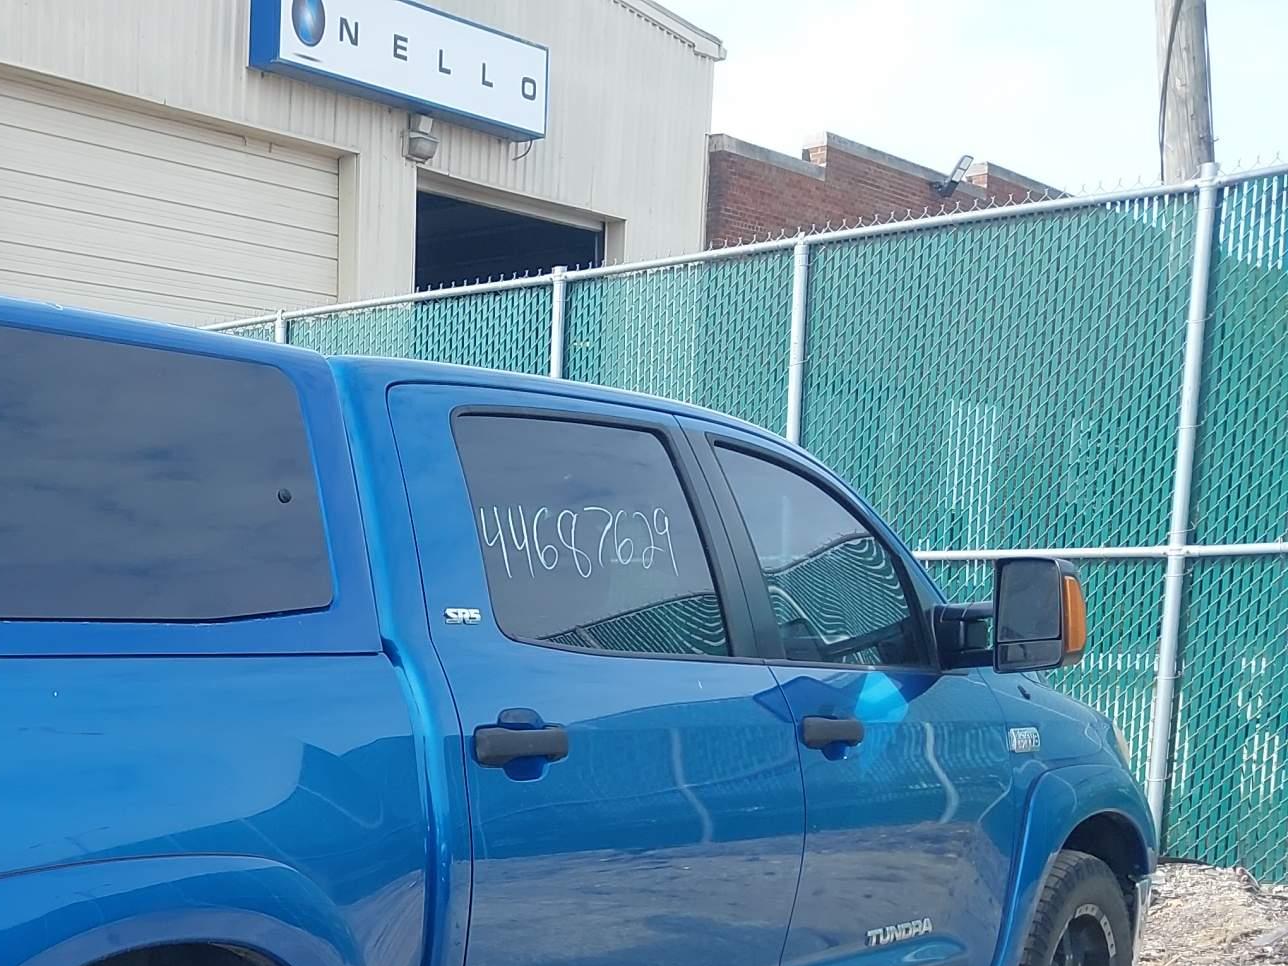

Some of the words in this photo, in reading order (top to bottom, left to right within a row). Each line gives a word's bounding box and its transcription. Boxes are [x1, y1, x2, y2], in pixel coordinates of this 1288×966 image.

[479, 504, 679, 579] 44687629
[444, 608, 481, 625] SR5
[865, 917, 933, 946] TUNDRA
